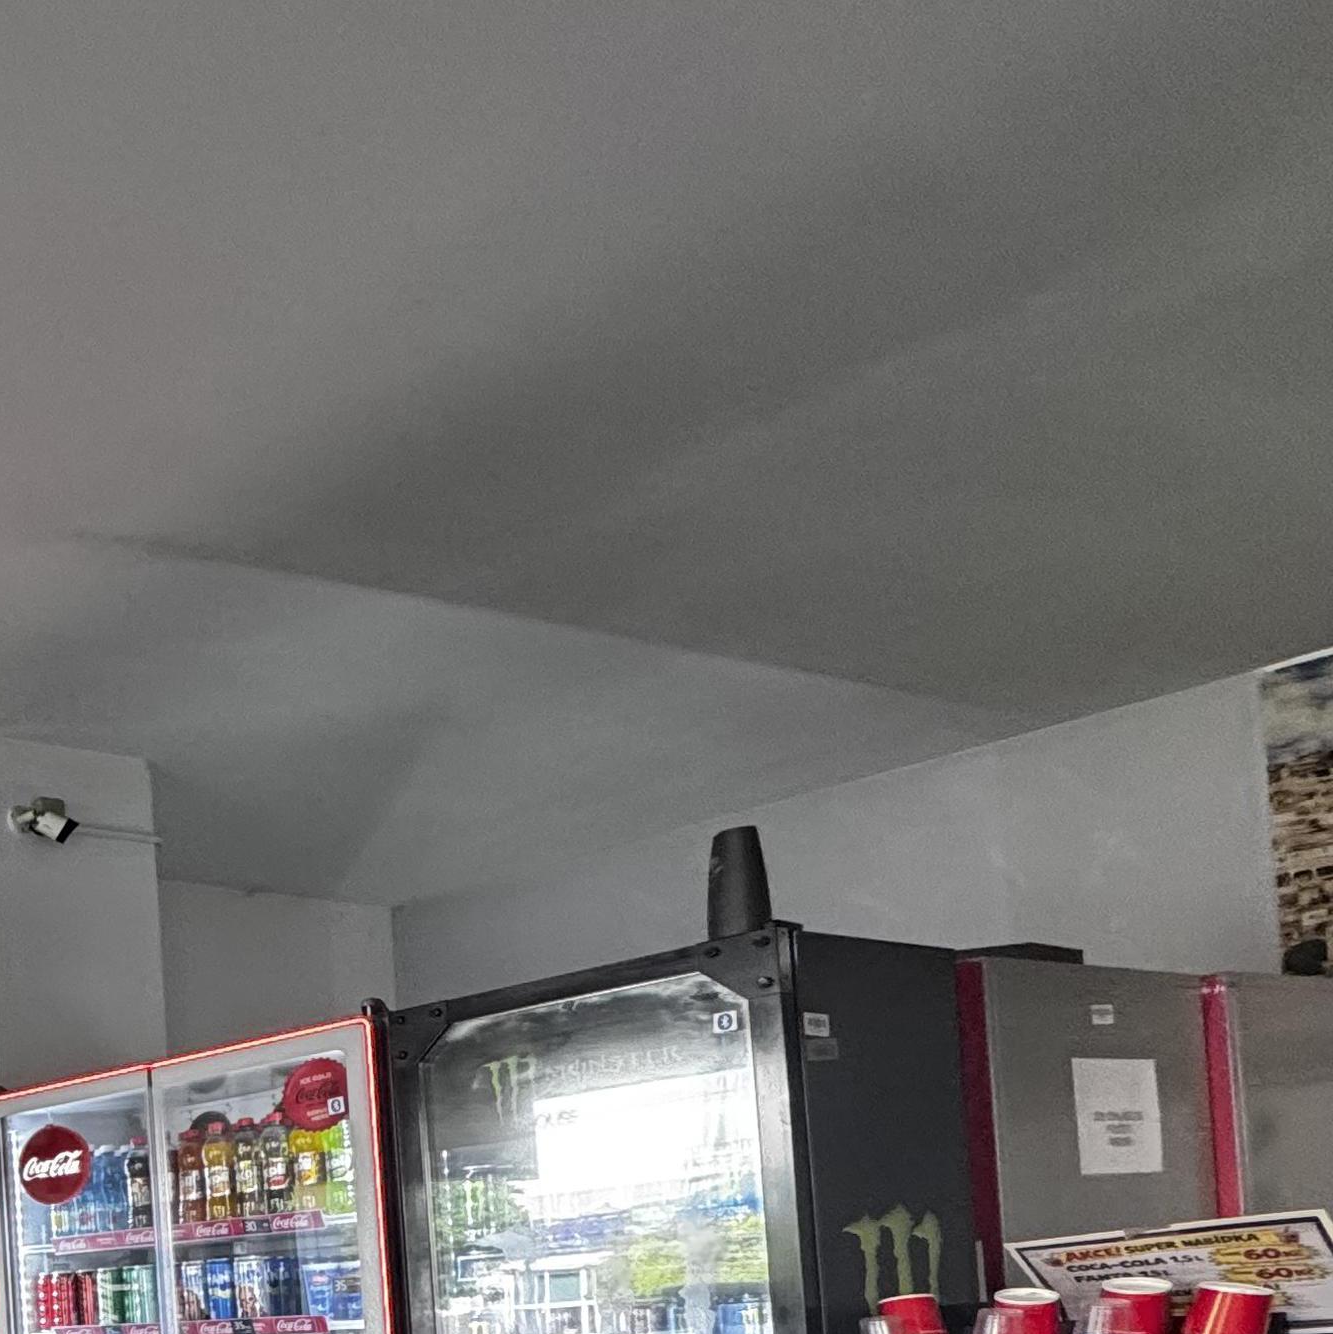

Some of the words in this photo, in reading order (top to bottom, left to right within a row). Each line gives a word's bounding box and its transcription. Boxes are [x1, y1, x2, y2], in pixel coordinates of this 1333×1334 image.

[23, 1150, 83, 1181] Coca-Cola
[272, 1216, 310, 1229] Coca-Cola
[1066, 1246, 1121, 1261] AKCE!
[1124, 1241, 1176, 1253] SUPER
[1066, 1257, 1167, 1272] COCA-COLA
[277, 1319, 312, 1332] Coca-Cola
